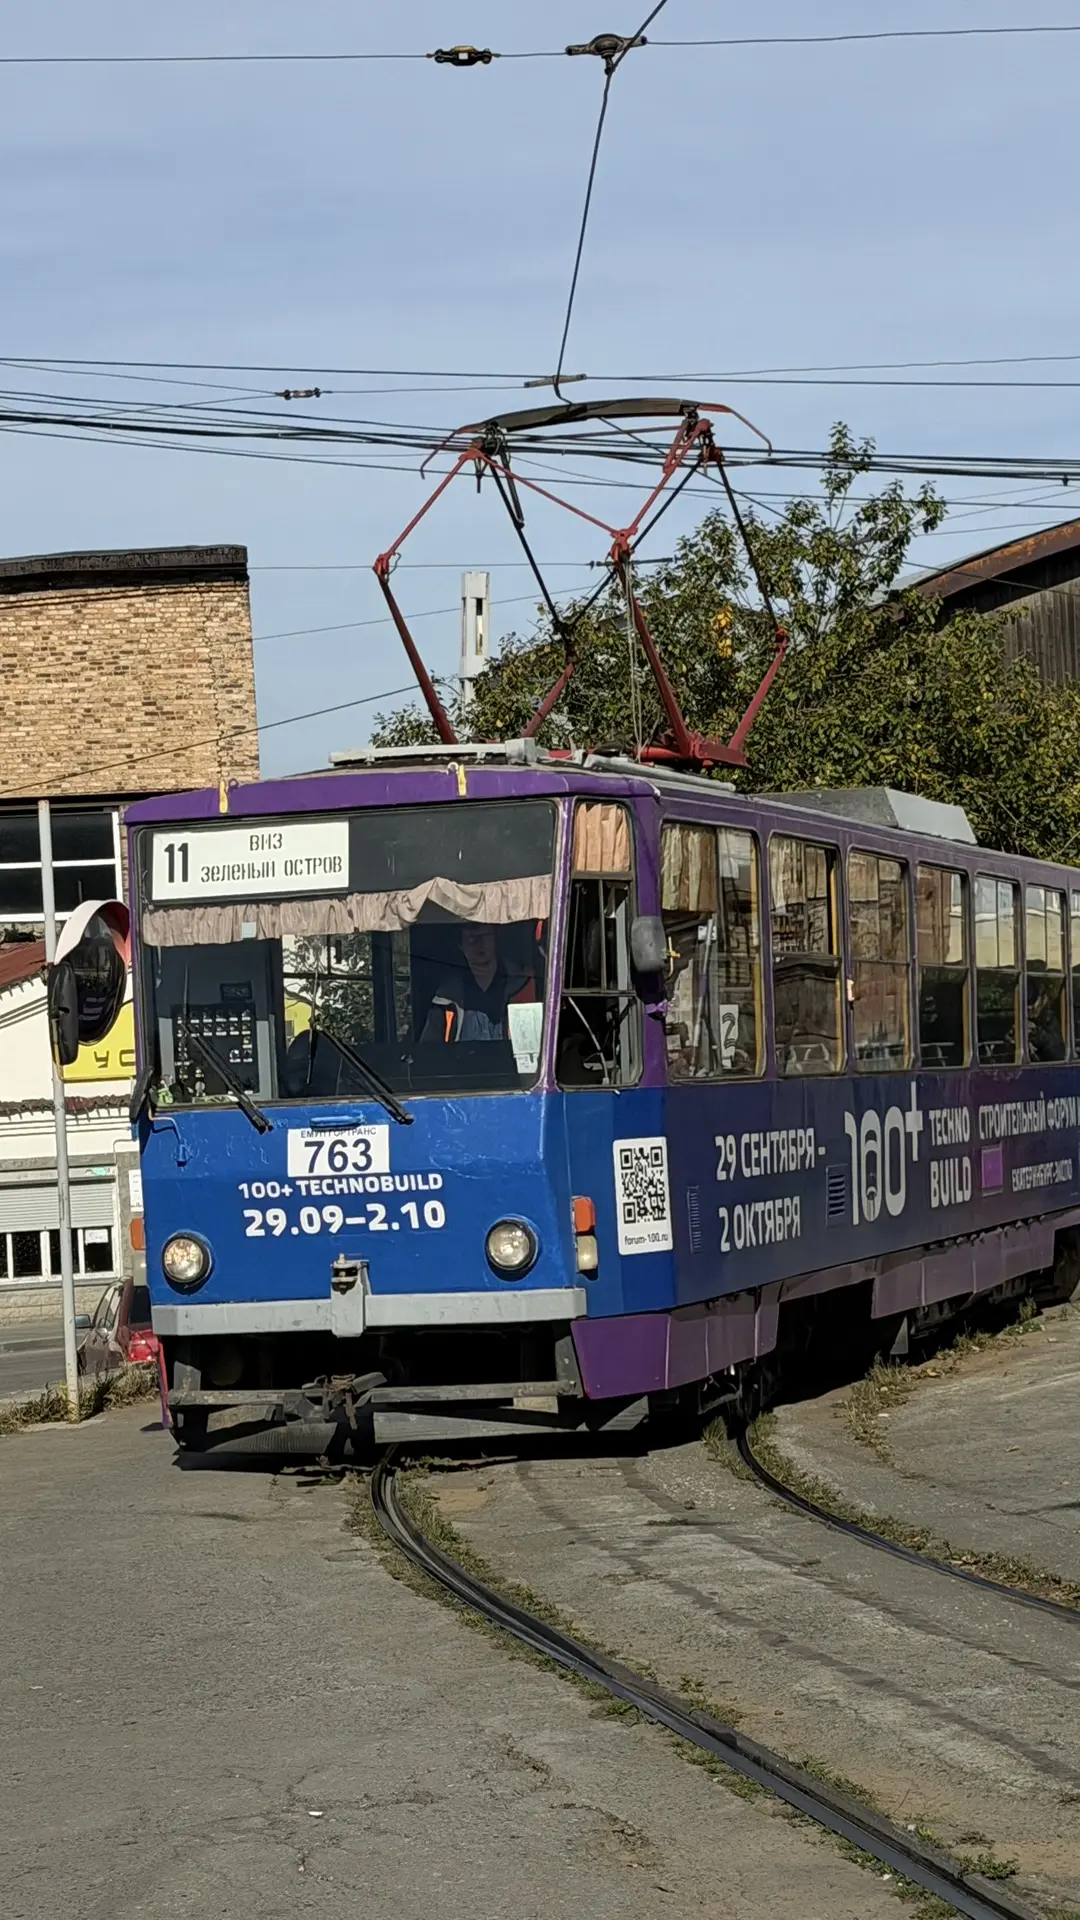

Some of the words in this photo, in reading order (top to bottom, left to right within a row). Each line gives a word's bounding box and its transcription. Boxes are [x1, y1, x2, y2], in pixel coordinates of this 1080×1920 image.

[163, 842, 189, 883] 11
[249, 833, 283, 851] ВИЗ
[283, 855, 342, 877] ОСТРОВ
[722, 1012, 736, 1049] 2
[929, 1105, 971, 1146] TECHNO
[979, 1090, 1046, 1140] СТРОИТЕЛЬНЫЙ
[1047, 1096, 1077, 1130] ФОРУМ
[304, 1138, 372, 1174] 763
[715, 1134, 737, 1182] 29
[741, 1127, 816, 1178] СЕНТЯБРЯ
[238, 1181, 293, 1200] 100+
[296, 1173, 443, 1197] TECHNOBUILD
[930, 1156, 972, 1208] BUILD
[718, 1206, 731, 1253] 2
[734, 1195, 801, 1250] ОКТЯБРЯ
